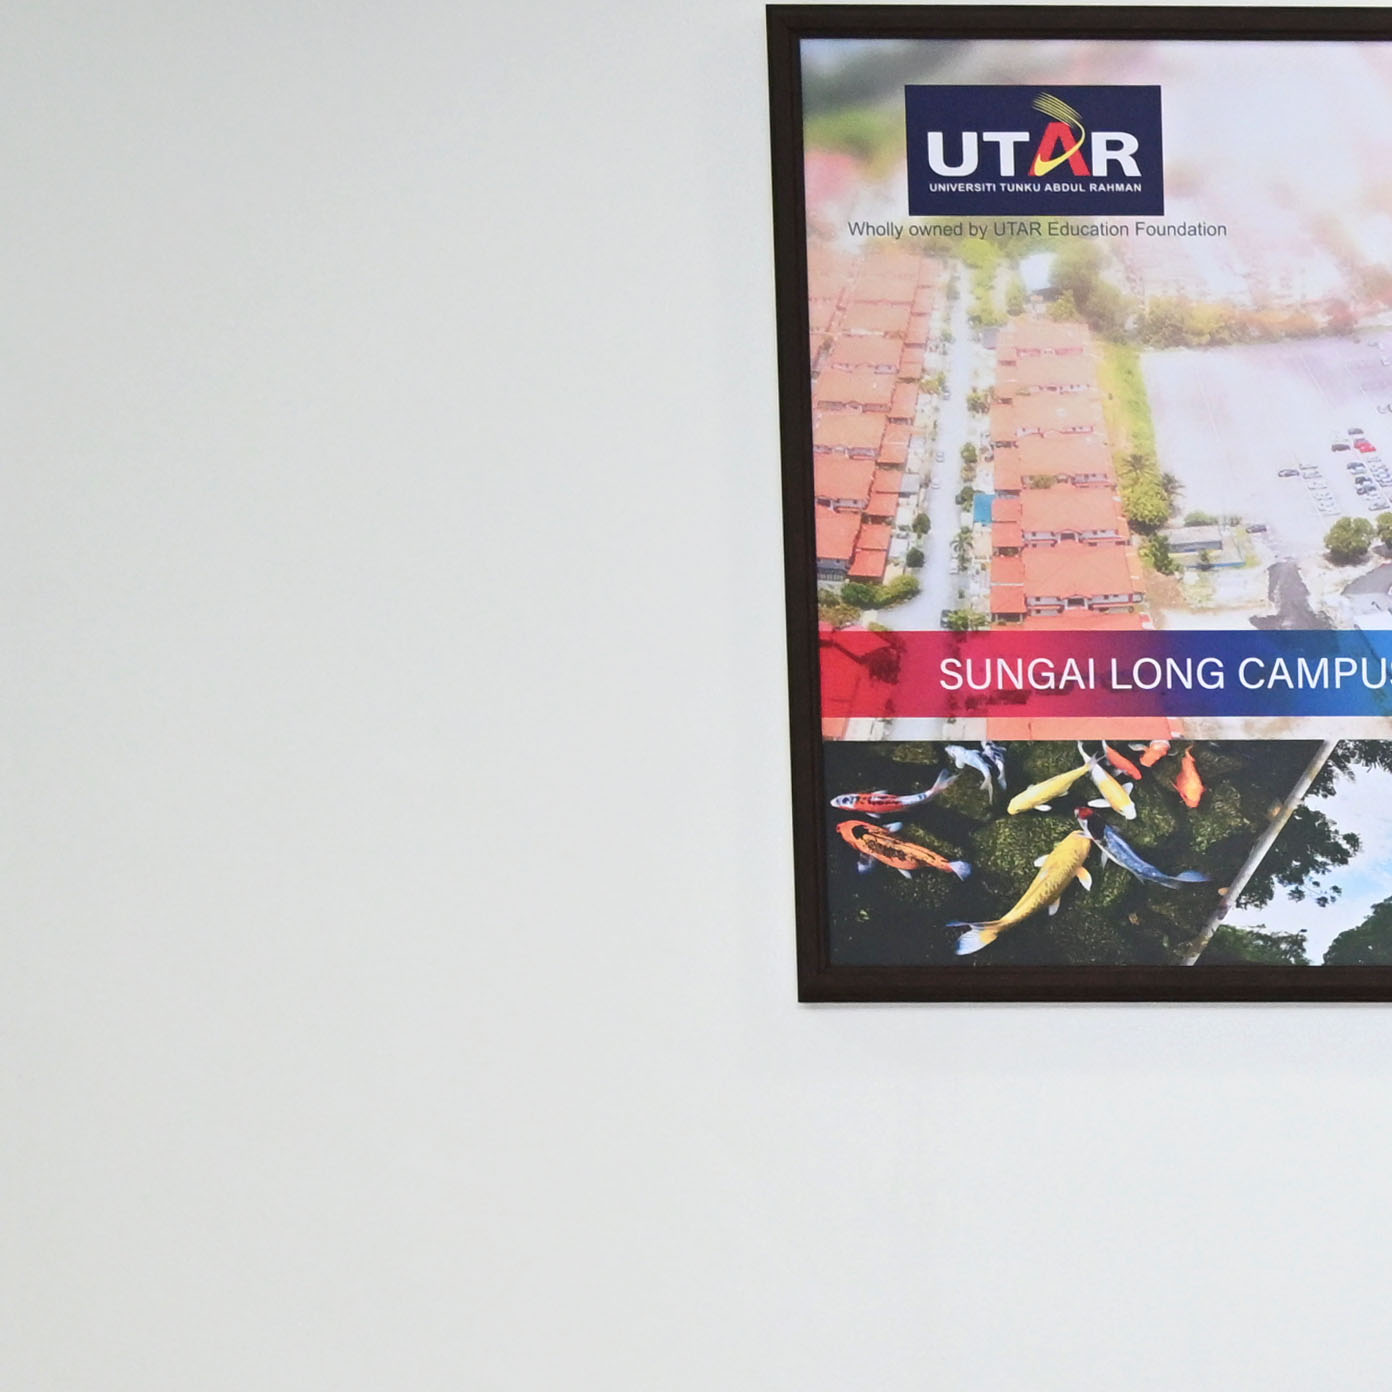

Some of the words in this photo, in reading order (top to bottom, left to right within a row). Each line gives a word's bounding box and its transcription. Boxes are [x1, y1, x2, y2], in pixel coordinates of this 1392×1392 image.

[927, 121, 1141, 178] UTAR
[929, 182, 997, 192] UNIVERSITI
[1000, 182, 1042, 192] TUNKU
[1044, 182, 1087, 192] ABDUL
[1089, 182, 1142, 192] RAHMAN
[848, 221, 905, 240] Wholly
[909, 221, 964, 238] owned
[968, 221, 989, 240] by
[993, 221, 1042, 238] UTAR
[1047, 221, 1129, 238] Education
[1134, 221, 1228, 238] Foundation
[939, 656, 1097, 691] SUNGAI
[1110, 656, 1224, 691] LONG
